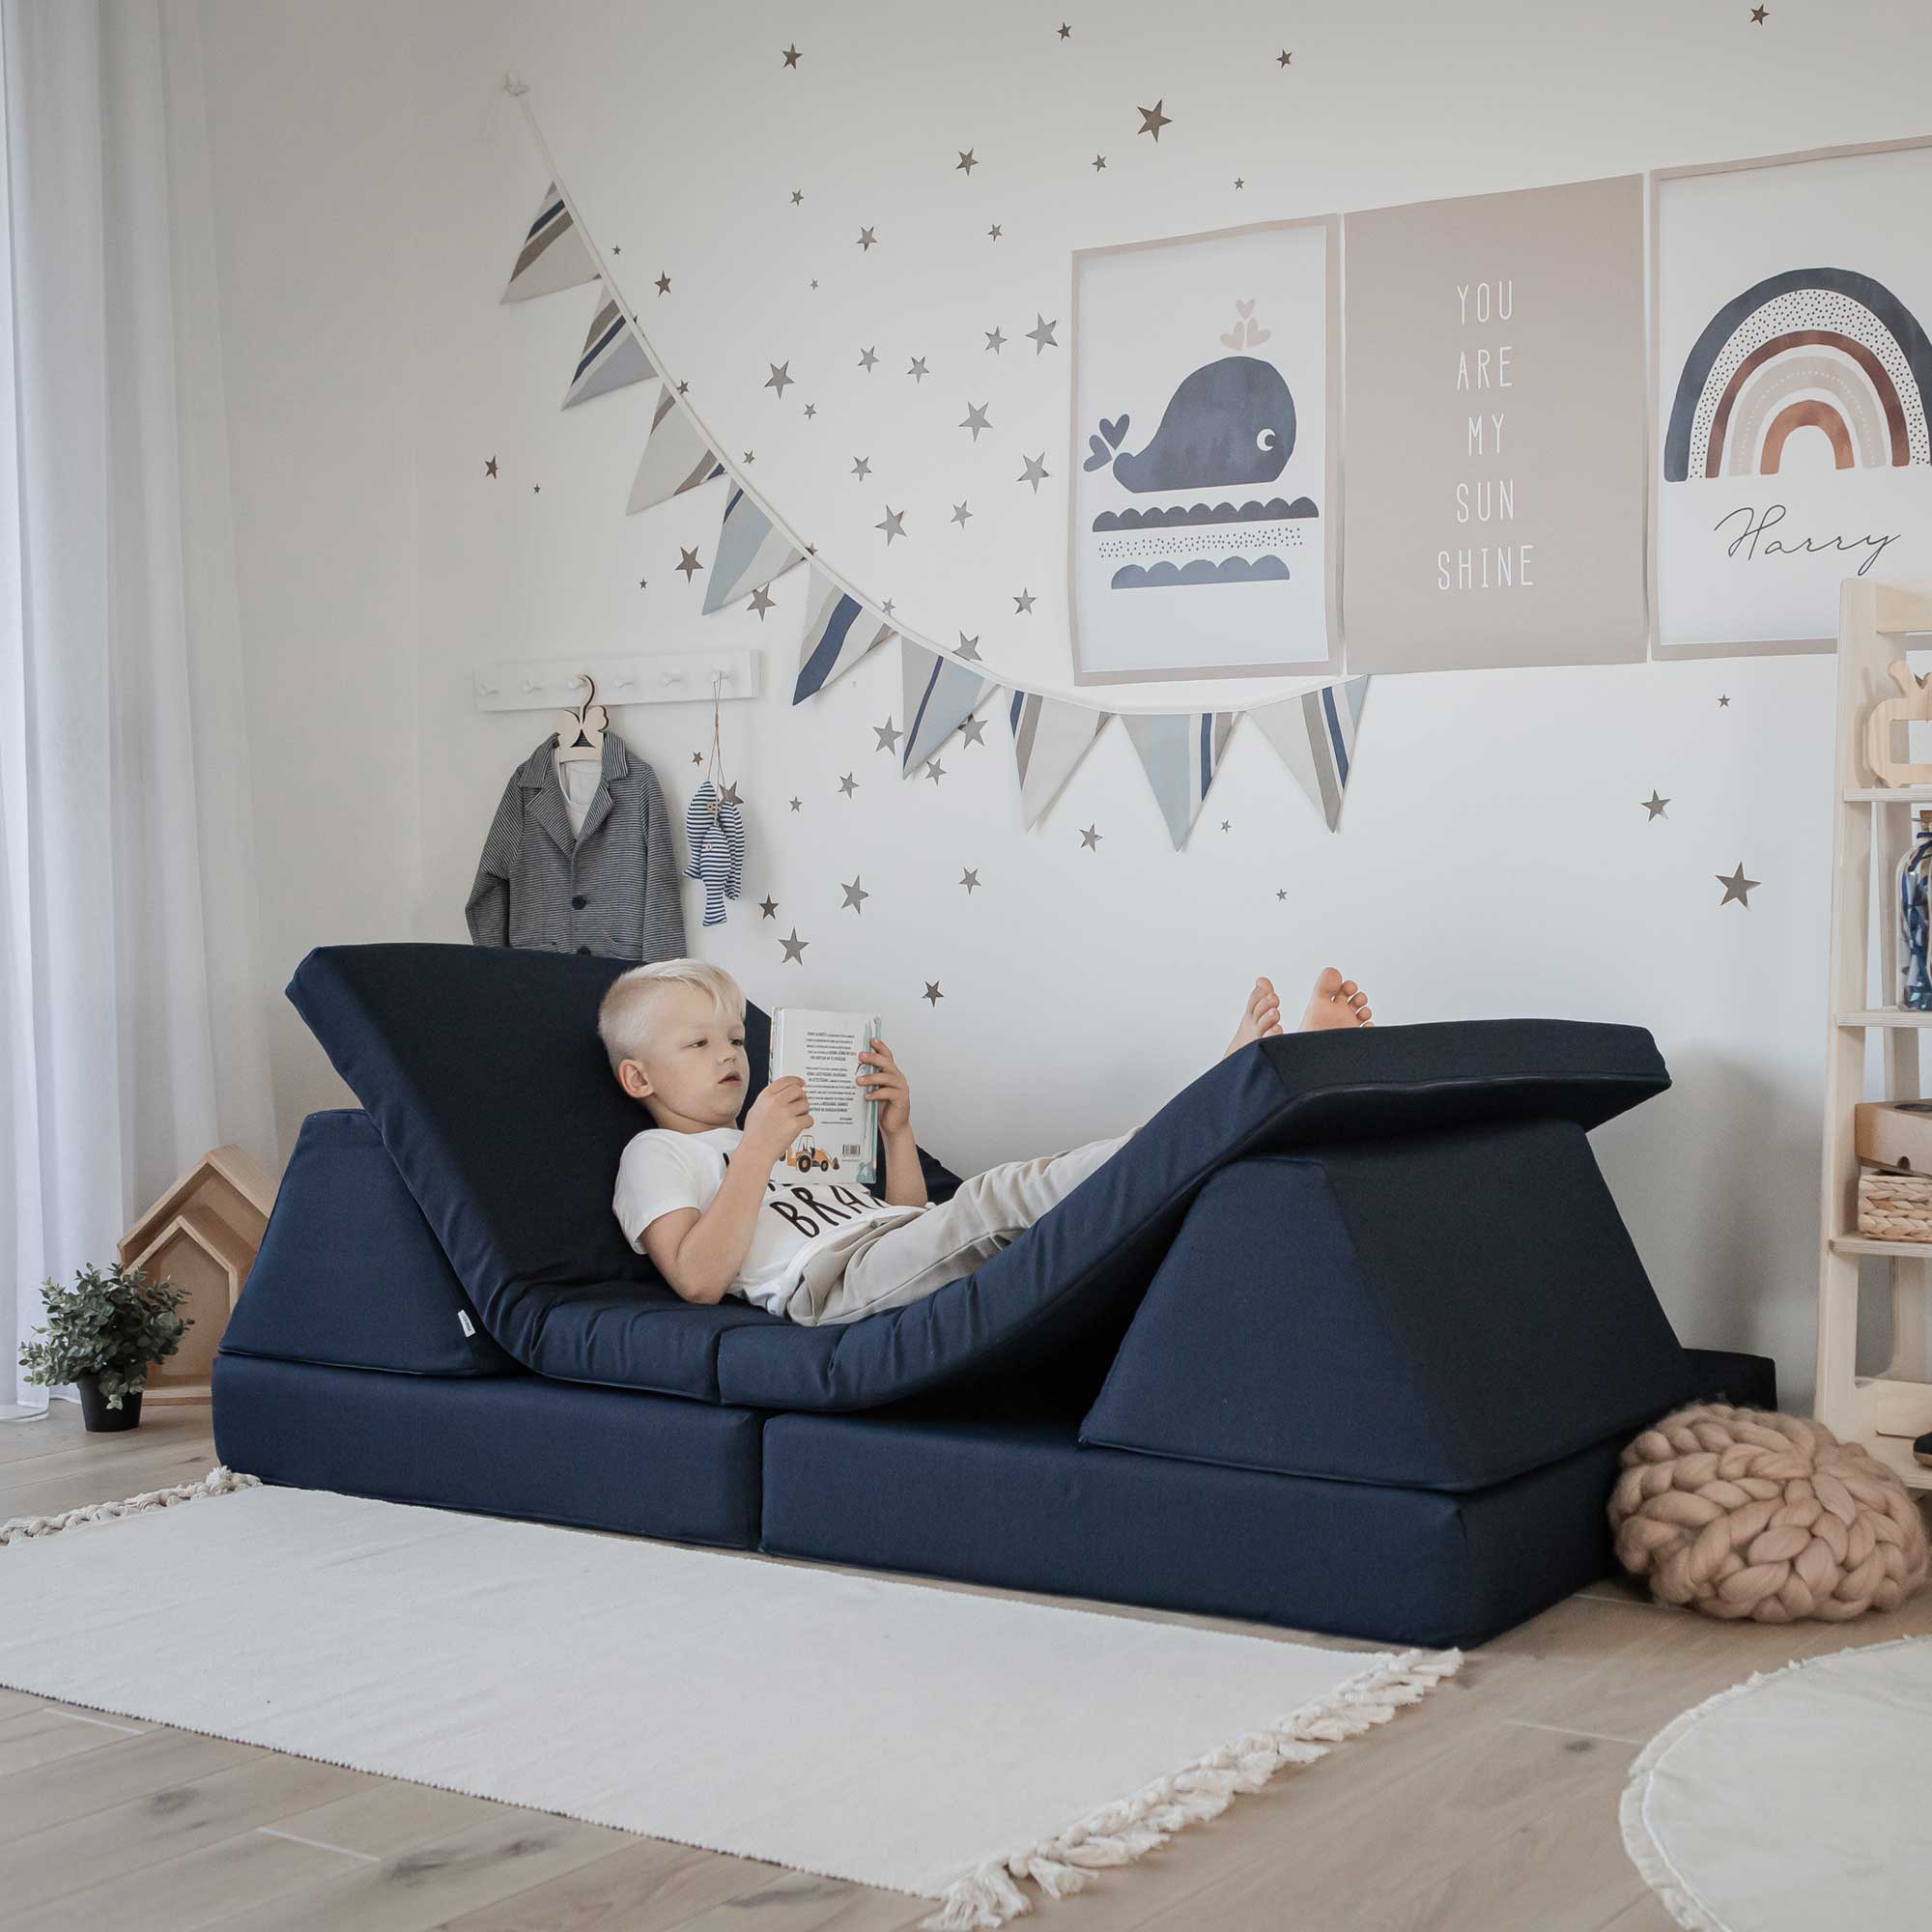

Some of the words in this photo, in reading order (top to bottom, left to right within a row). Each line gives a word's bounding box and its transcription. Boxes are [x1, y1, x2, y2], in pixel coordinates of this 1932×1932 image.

[1456, 279, 1514, 326] YOU
[1456, 345, 1514, 391] ARE
[1467, 412, 1505, 457] MY
[1456, 479, 1514, 524] SUN
[1714, 504, 1901, 577] Harry
[1437, 545, 1534, 591] SHINE
[769, 1184, 889, 1238] BRA
